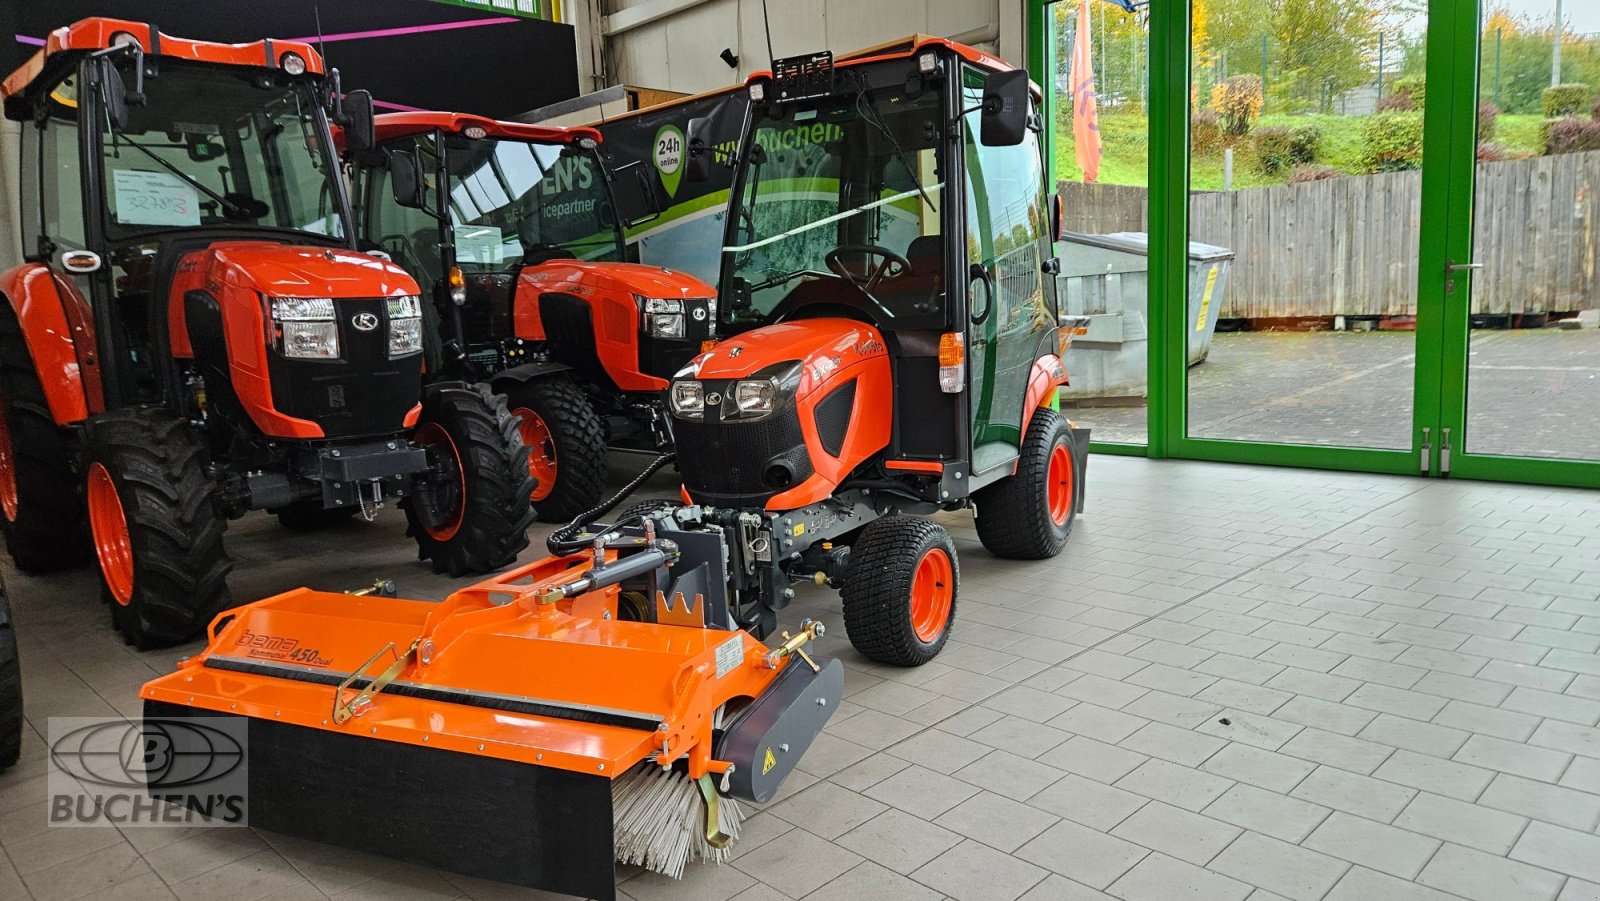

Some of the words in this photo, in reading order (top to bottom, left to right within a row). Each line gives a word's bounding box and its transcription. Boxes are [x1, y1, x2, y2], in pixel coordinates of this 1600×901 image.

[658, 137, 680, 156] 24h
[660, 156, 679, 167] online
[235, 629, 299, 653] bema
[289, 647, 319, 662] 450
